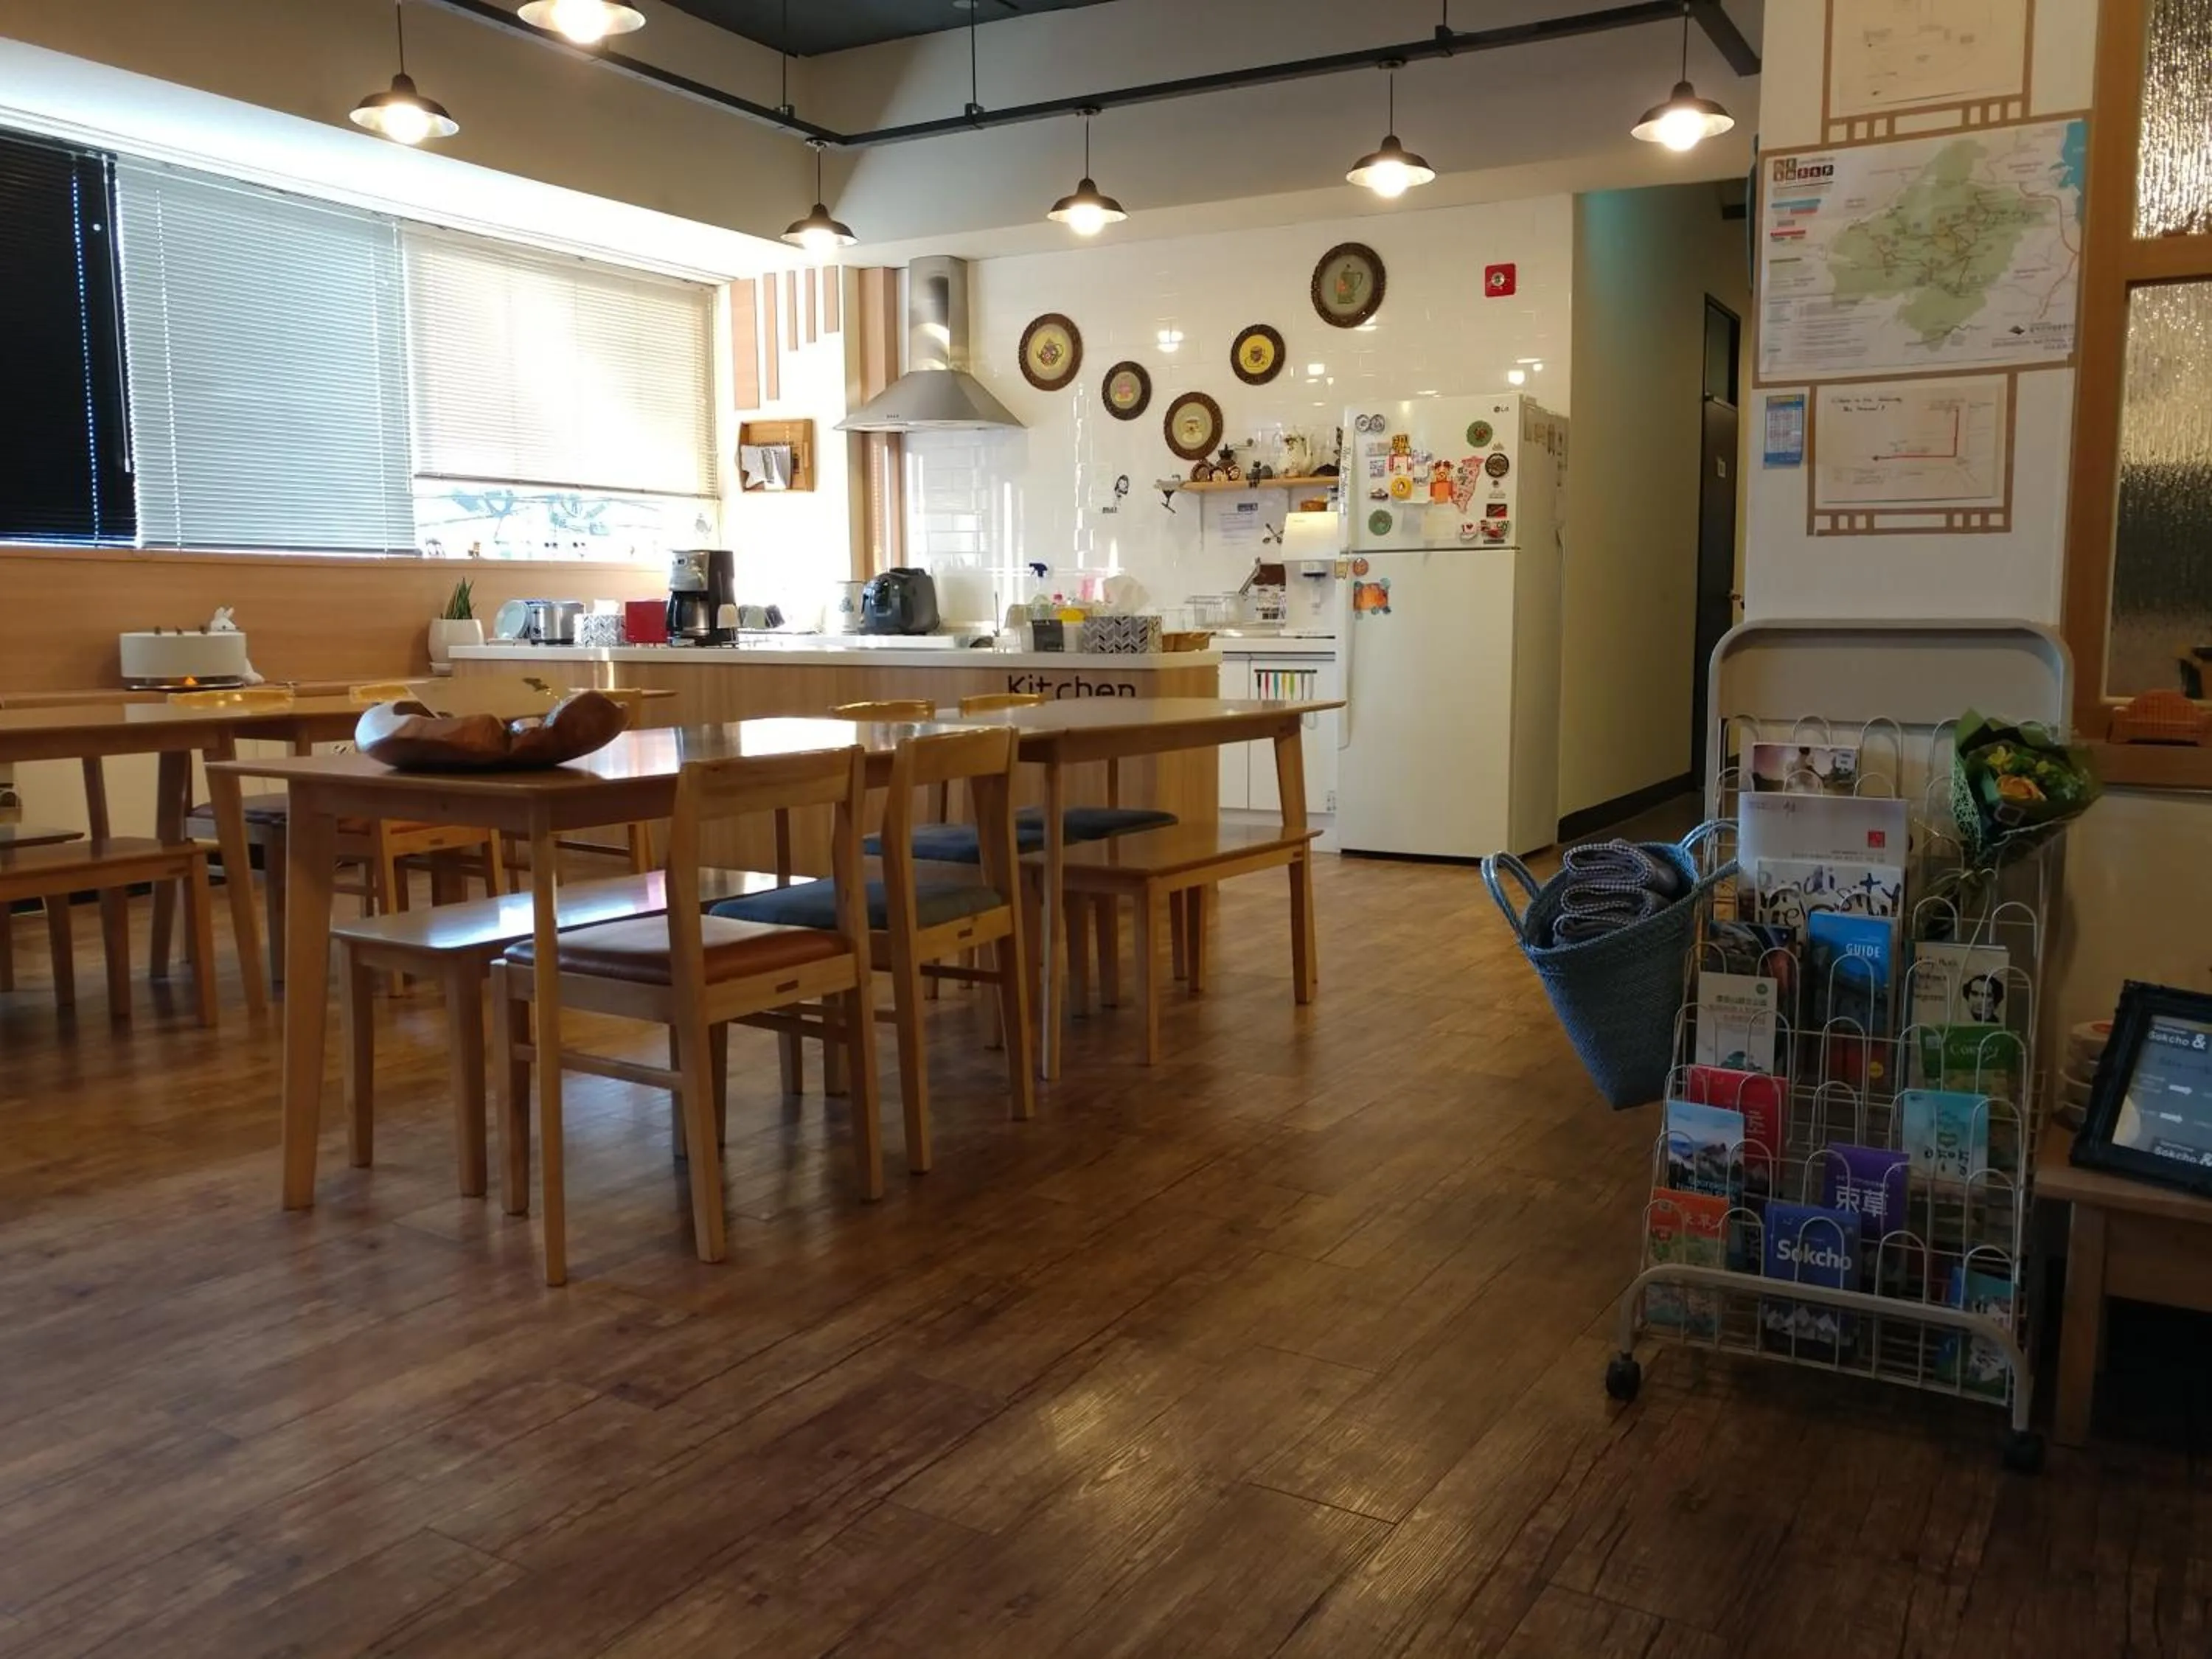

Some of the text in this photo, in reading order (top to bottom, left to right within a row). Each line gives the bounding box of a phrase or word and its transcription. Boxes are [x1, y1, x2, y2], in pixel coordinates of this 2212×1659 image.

[1008, 674, 1135, 699] Kitchen
[1846, 943, 1881, 959] GUIDE
[2148, 1030, 2190, 1046] Sokcho
[1776, 1239, 1853, 1270] Sokcho
